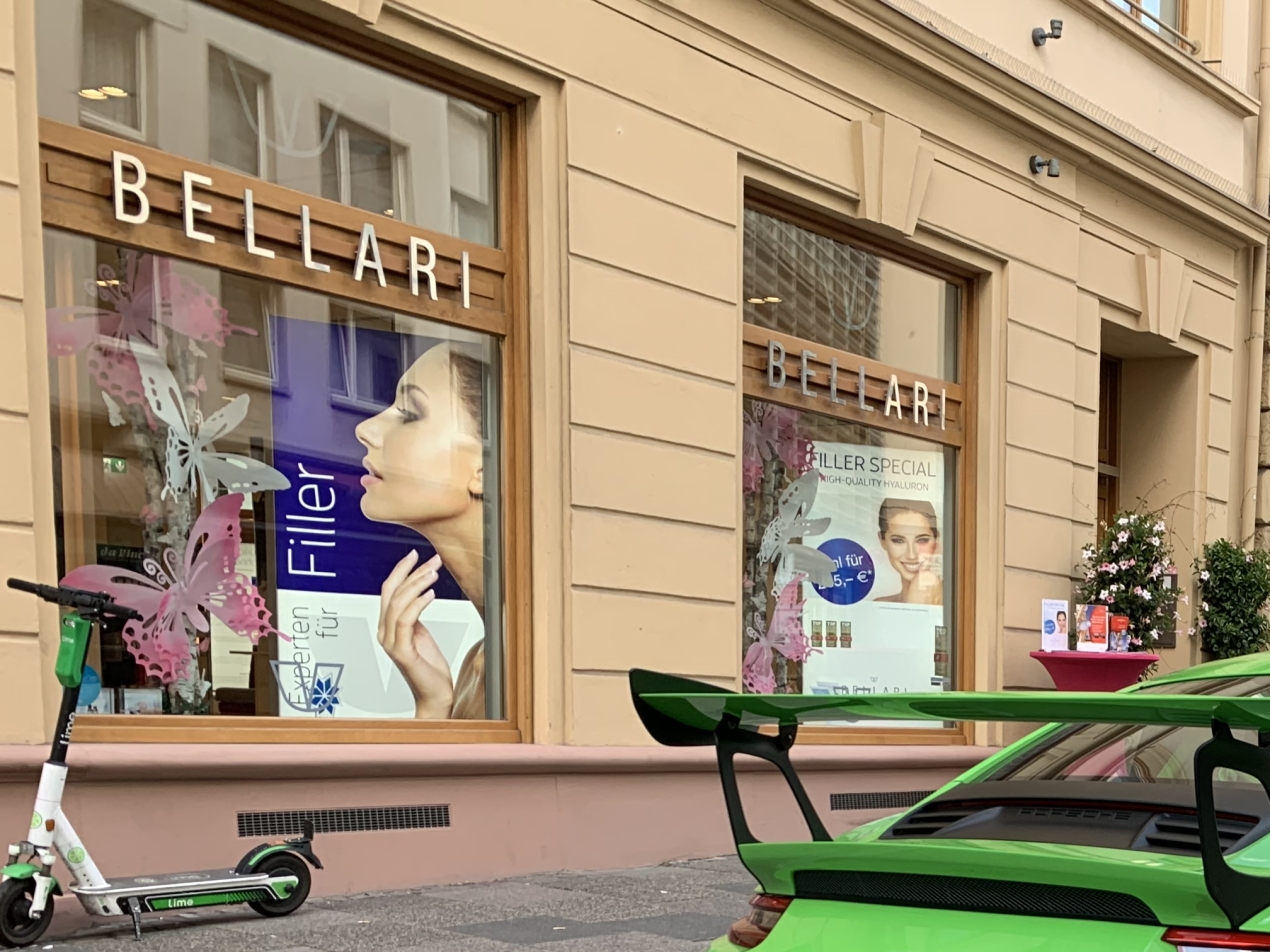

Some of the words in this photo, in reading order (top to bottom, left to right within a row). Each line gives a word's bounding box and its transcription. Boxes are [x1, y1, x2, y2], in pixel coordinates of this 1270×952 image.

[112, 149, 471, 310] BELLARI
[767, 338, 946, 431] BELLARI
[869, 456, 937, 478] SPECIAL
[883, 481, 929, 492] HYALURON
[285, 462, 337, 578] Filler
[845, 553, 864, 568] für
[315, 607, 338, 639] für
[287, 605, 313, 706] Experten
[60, 711, 77, 745] Lime
[168, 898, 194, 908] Lime
